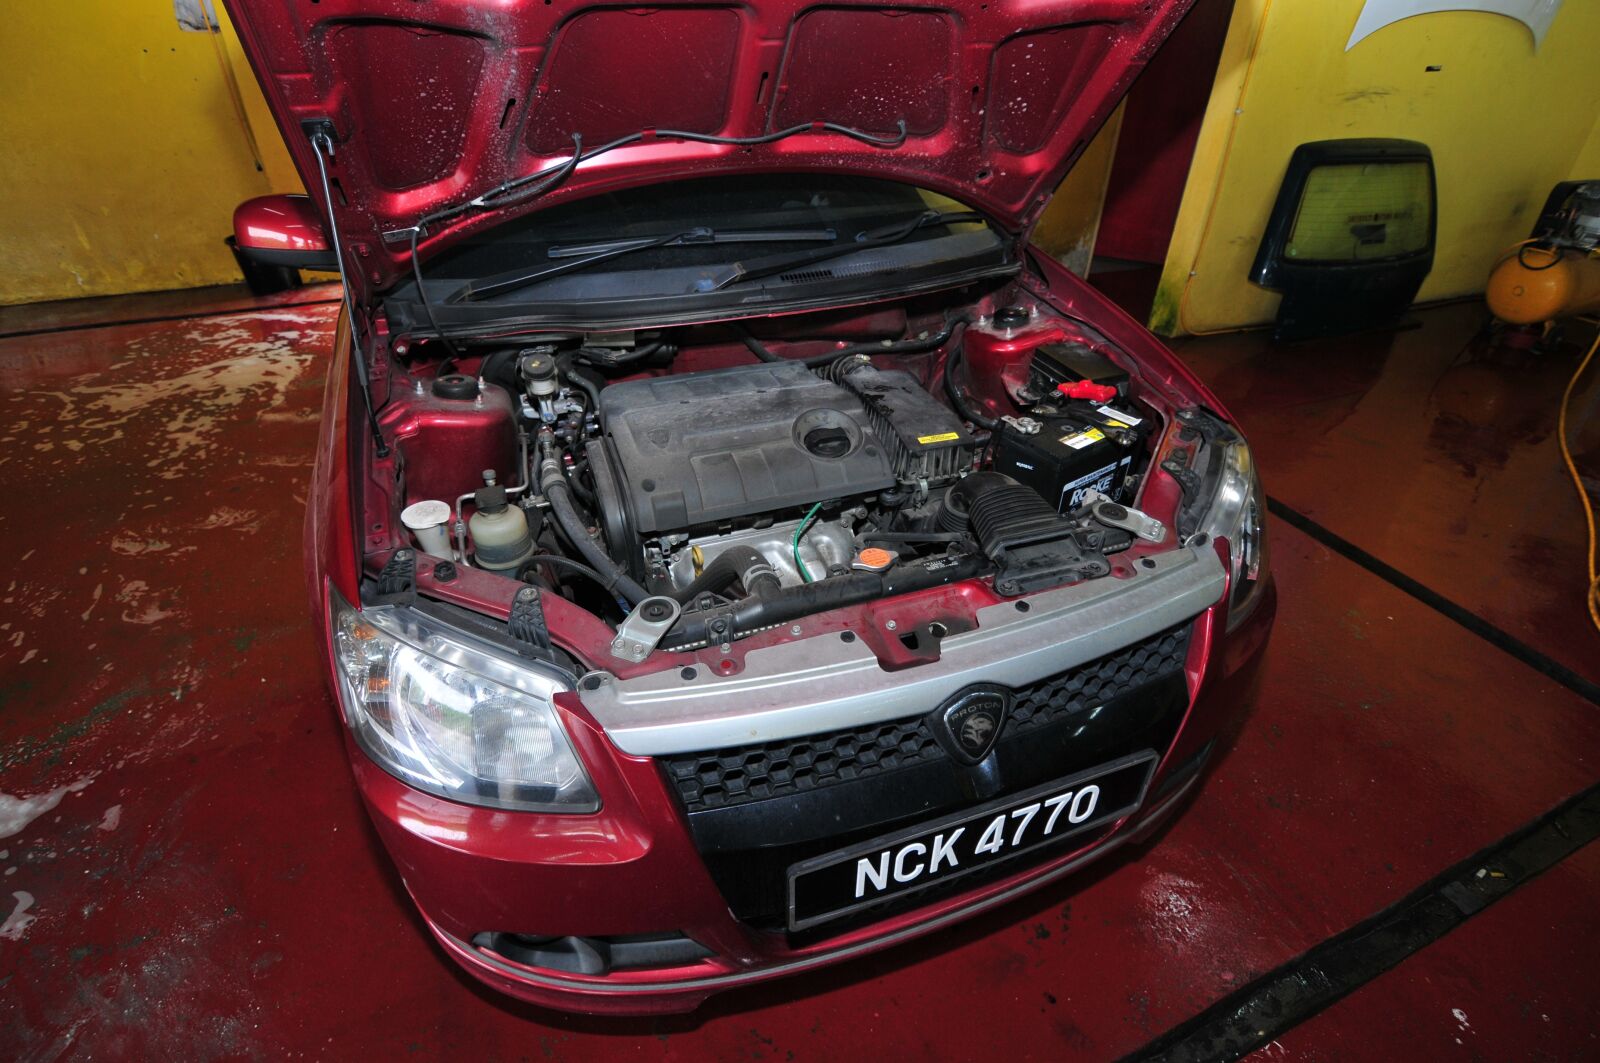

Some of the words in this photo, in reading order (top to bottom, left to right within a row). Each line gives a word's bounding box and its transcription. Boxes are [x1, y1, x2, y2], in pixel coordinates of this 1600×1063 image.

[950, 702, 1001, 721] PROTON
[855, 827, 966, 898] NCK
[974, 784, 1100, 855] 4770
